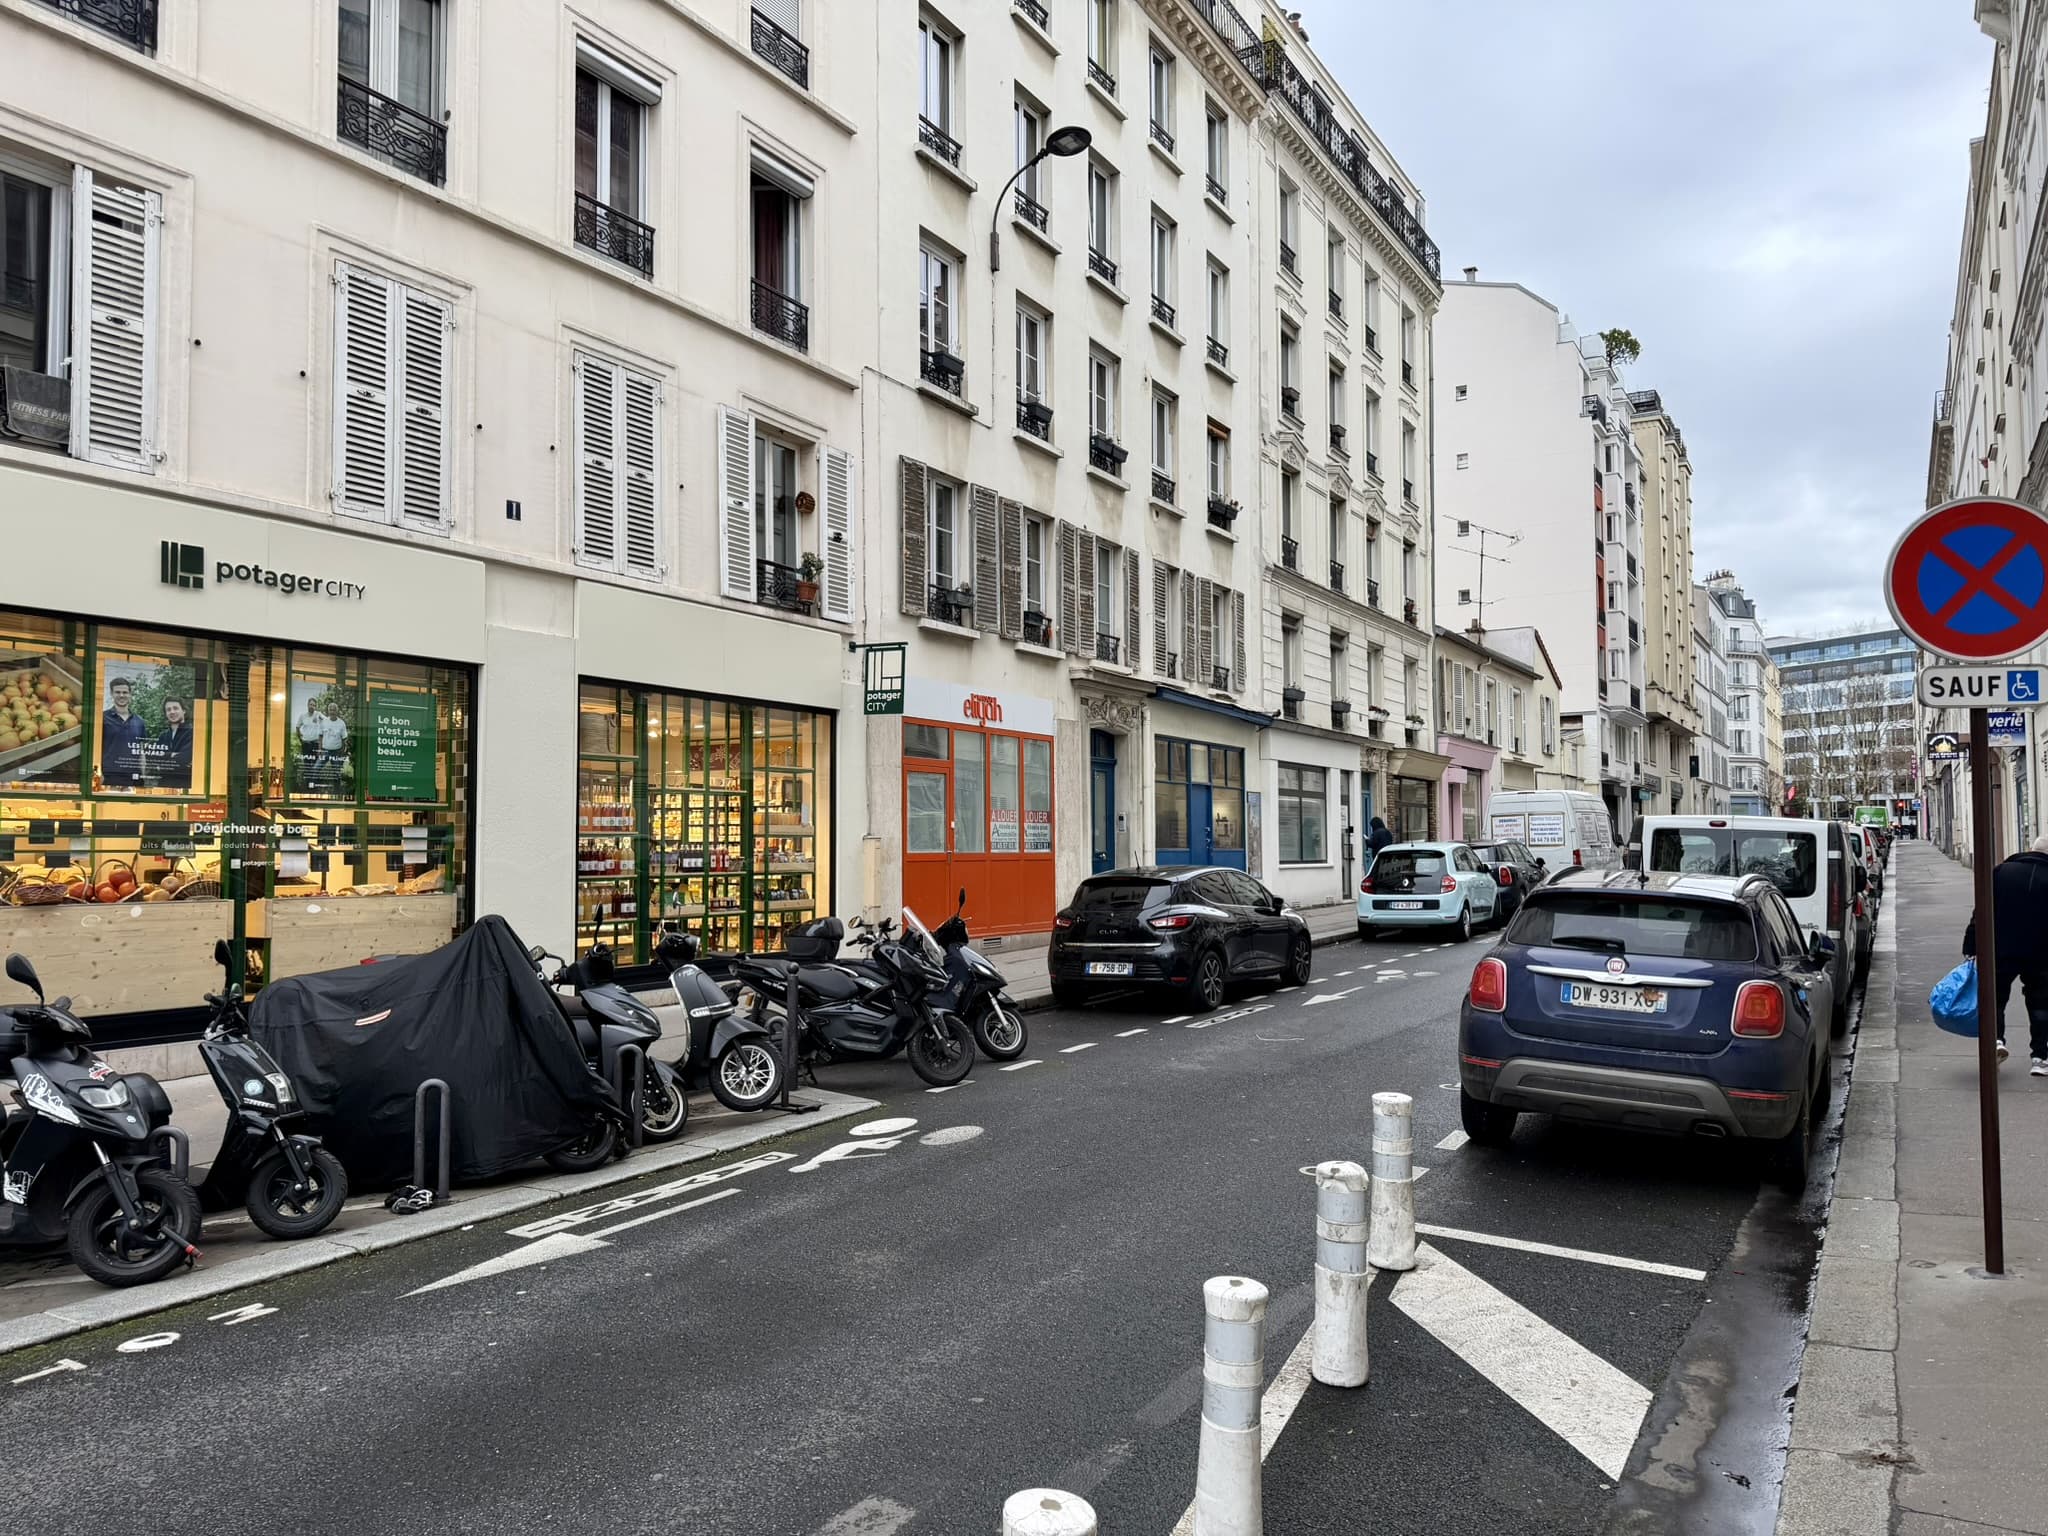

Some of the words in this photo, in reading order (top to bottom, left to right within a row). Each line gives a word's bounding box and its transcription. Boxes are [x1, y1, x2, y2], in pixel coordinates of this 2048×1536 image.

[1929, 676, 2001, 697] SAUF
[867, 691, 901, 701] potager
[866, 702, 887, 711] CITY
[378, 716, 390, 725] Le
[391, 717, 411, 726] bon
[1988, 713, 2024, 728] verie
[377, 726, 401, 736] n'est
[403, 728, 420, 738] pas
[377, 738, 418, 748] toujours
[377, 747, 405, 757] beau.
[194, 822, 266, 834] Dénicheurs
